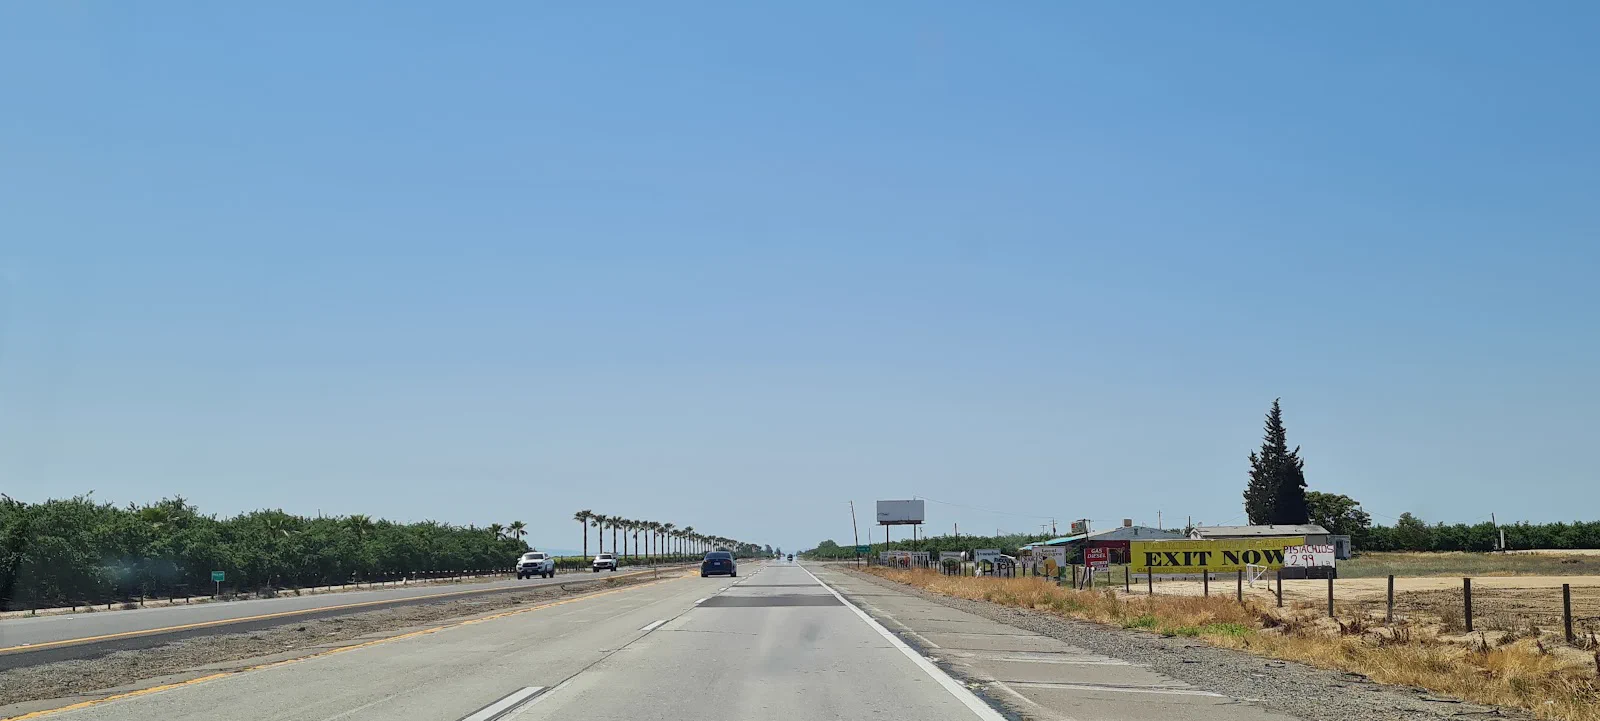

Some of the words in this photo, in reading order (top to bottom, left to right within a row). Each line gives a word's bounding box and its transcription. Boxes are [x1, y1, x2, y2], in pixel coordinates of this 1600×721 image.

[1283, 545, 1334, 554] PISTACHIOS
[1143, 551, 1212, 567] EXIT
[1221, 549, 1285, 566] NOW
